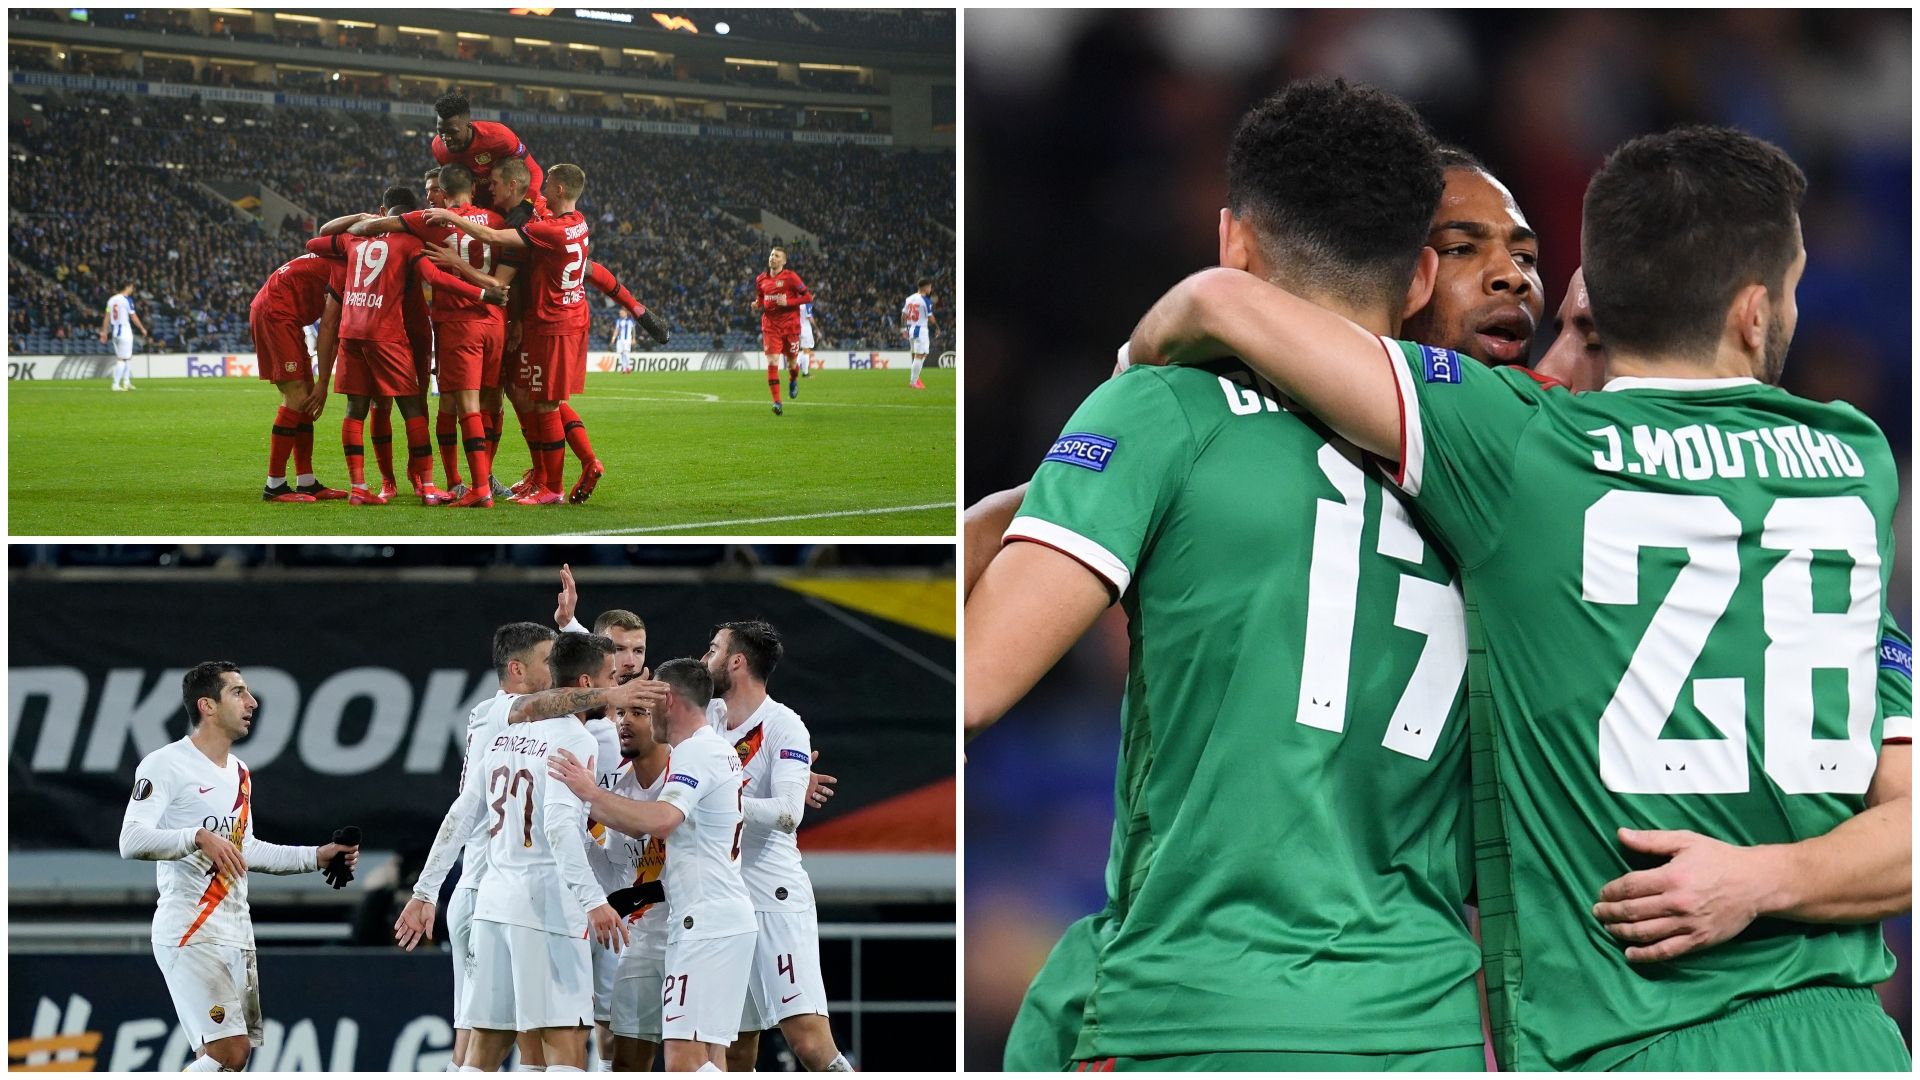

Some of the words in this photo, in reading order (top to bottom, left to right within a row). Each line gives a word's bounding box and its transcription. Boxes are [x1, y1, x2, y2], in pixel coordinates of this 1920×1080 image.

[353, 240, 389, 288] 19
[367, 294, 384, 309] 04
[186, 356, 252, 378] FedEx
[849, 351, 889, 370] FedEx
[1587, 423, 1865, 481] J.MOUTINHO
[1295, 436, 1469, 761] 17
[1582, 489, 1882, 795] 28
[491, 735, 549, 759] SPINZZOLA
[674, 775, 698, 787] RESPECT
[489, 764, 534, 849] 37
[776, 953, 796, 985] 4
[661, 973, 690, 1007] 21
